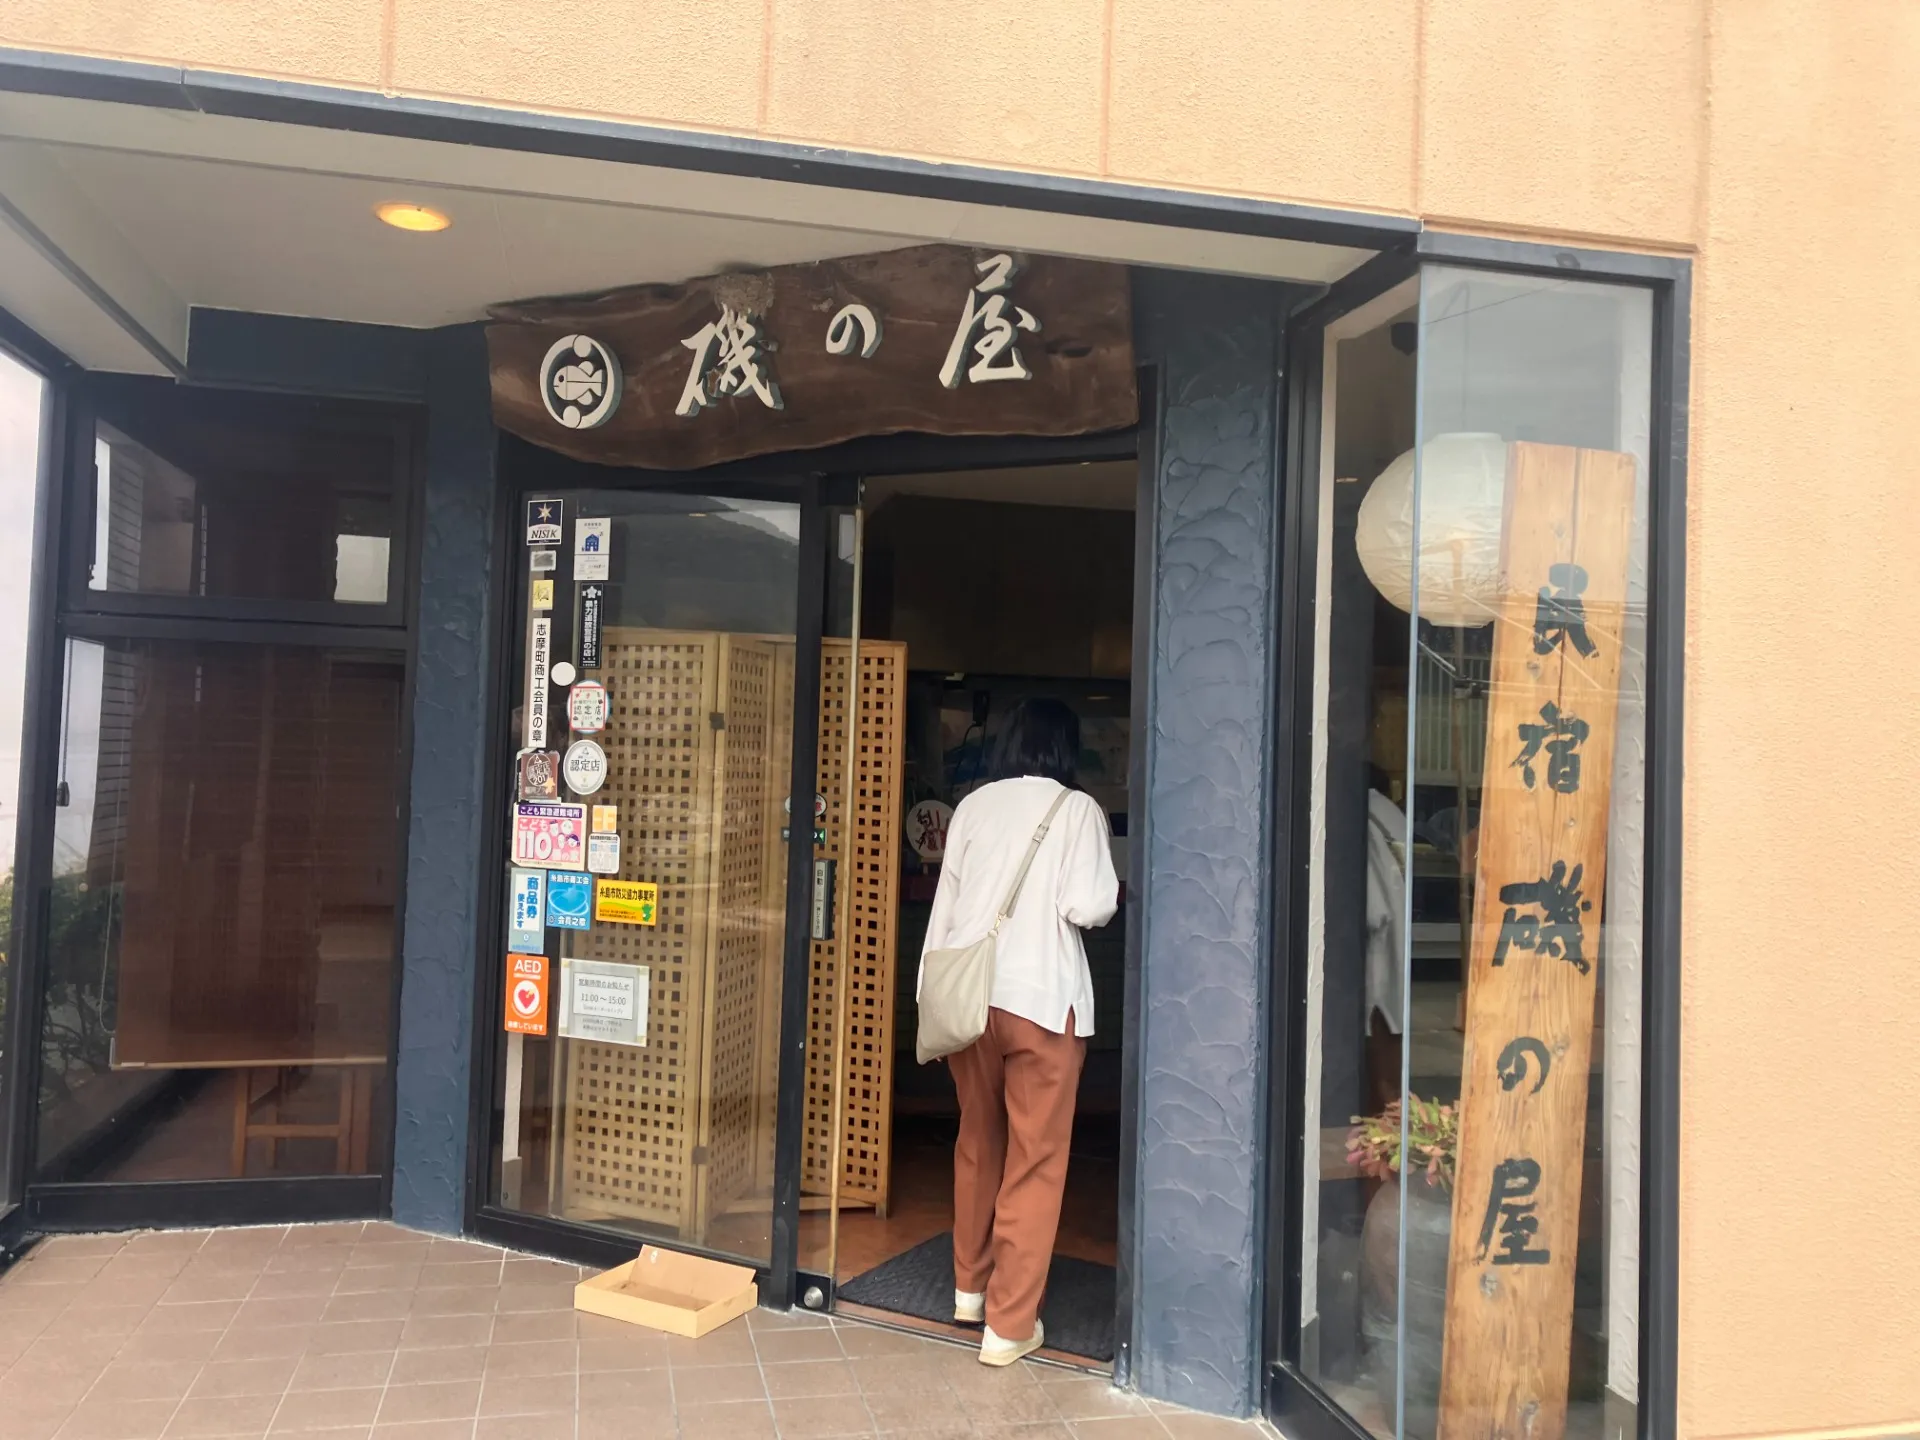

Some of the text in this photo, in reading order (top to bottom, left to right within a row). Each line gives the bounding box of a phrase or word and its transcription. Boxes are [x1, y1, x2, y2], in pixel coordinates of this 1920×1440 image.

[675, 254, 1042, 418] 磯の屋
[532, 624, 547, 741] 志摩町商工会員の章
[570, 759, 600, 772] 認定店
[520, 806, 580, 818] こども緊急避難場所
[519, 818, 548, 831] こども
[550, 874, 590, 885] 糸島市商工会
[527, 876, 539, 919] 商品券
[599, 886, 655, 902] 糸島市防災協力事業所
[1474, 562, 1600, 1266] 民宿磯の屋
[514, 959, 542, 974] AED
